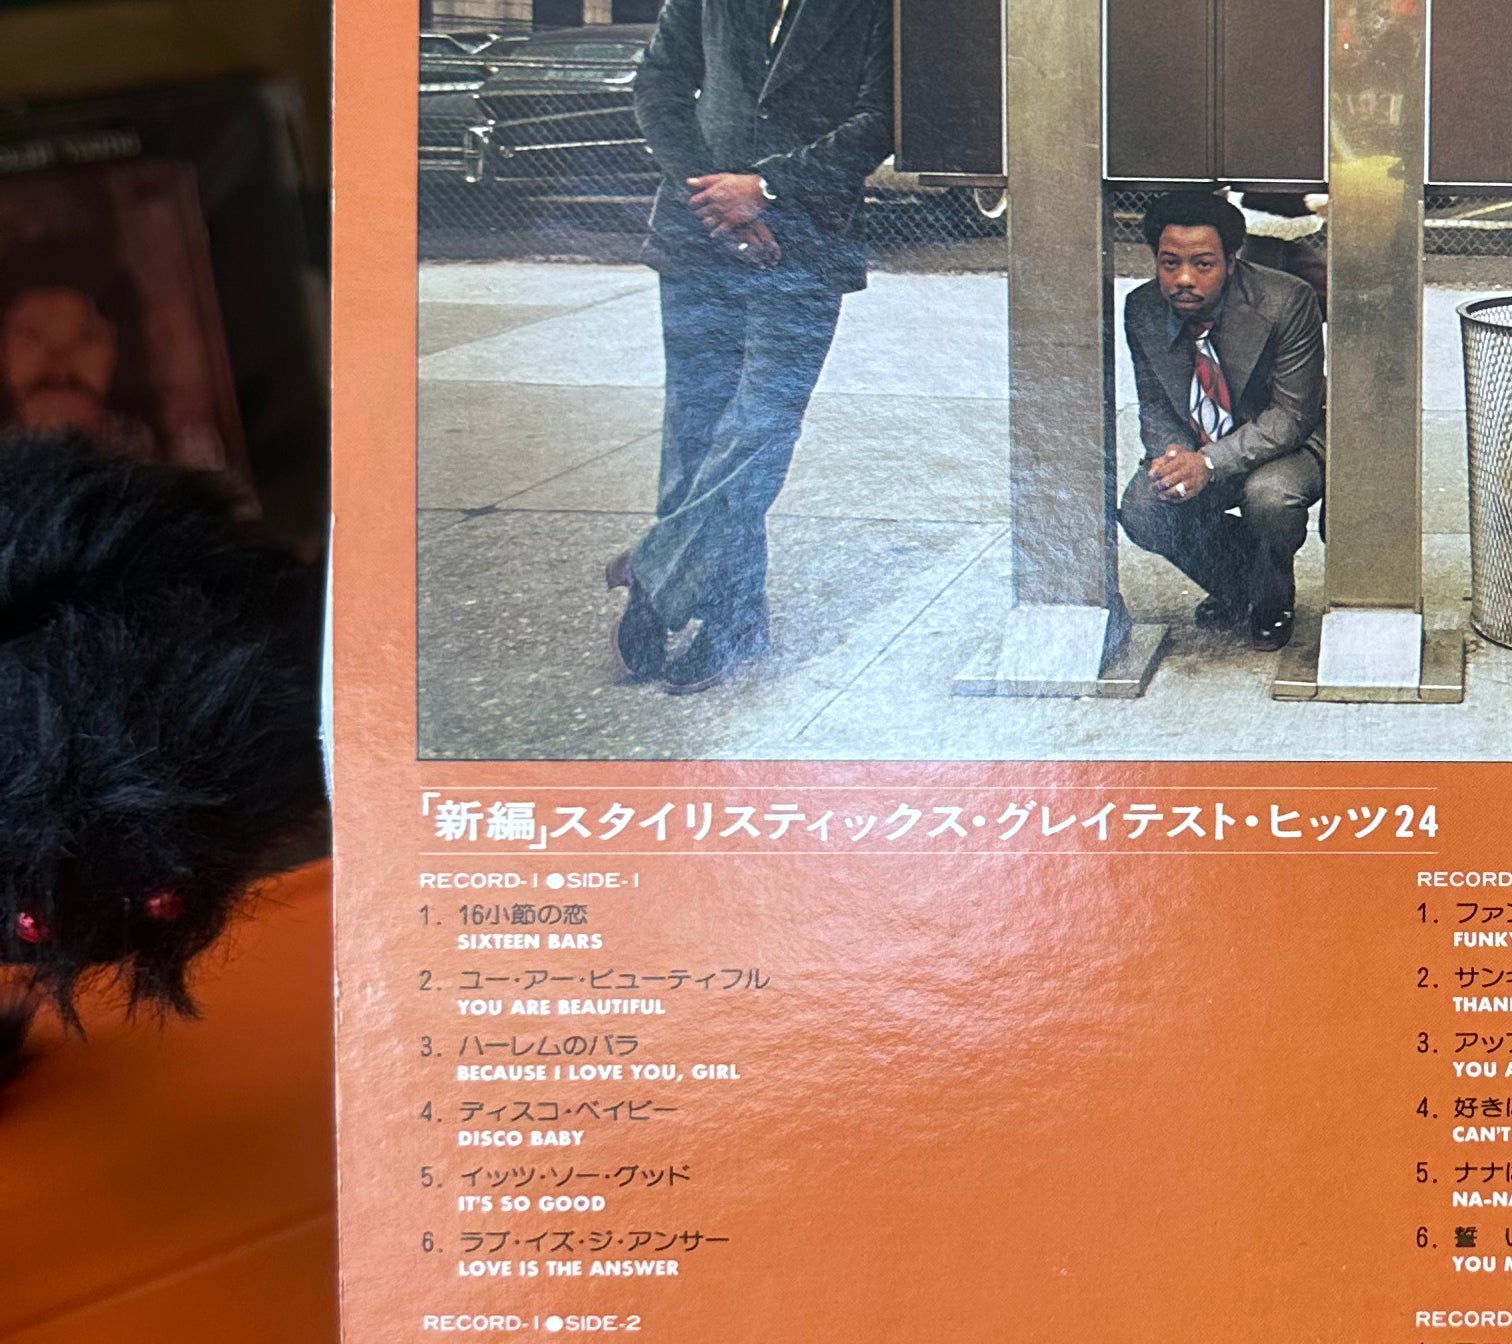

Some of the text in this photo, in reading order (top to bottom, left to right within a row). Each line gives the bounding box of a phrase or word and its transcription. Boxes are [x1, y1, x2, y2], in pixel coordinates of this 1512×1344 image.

[420, 903, 587, 925] 1. 16小節の恋
[1418, 903, 1438, 923] 1.
[457, 934, 602, 950] SIXTEEN BARS
[419, 970, 441, 990] 2.
[1418, 967, 1438, 988] 2.
[457, 999, 665, 1015] YOU ARE BEAUTIFUL
[421, 1035, 638, 1057] 3. ハーレムのバラ
[1418, 1032, 1437, 1053] 3.
[457, 1064, 740, 1081] BECAUSE I LOVE YOU, GIRL
[1453, 1062, 1496, 1077] YOU
[420, 1101, 442, 1122] 4.
[1417, 1097, 1437, 1118] 4.
[458, 1131, 584, 1146] DISCO BABY
[1453, 1127, 1511, 1142] CAN'T
[421, 1166, 442, 1187] 5.
[1417, 1162, 1437, 1183] 5.
[458, 1196, 605, 1212] IT'S SO GOOD
[422, 1232, 443, 1253] 6.
[1417, 1227, 1437, 1248] 6.
[458, 1260, 678, 1277] LOVE IS THE ANSWER
[1453, 1256, 1496, 1272] YOU
